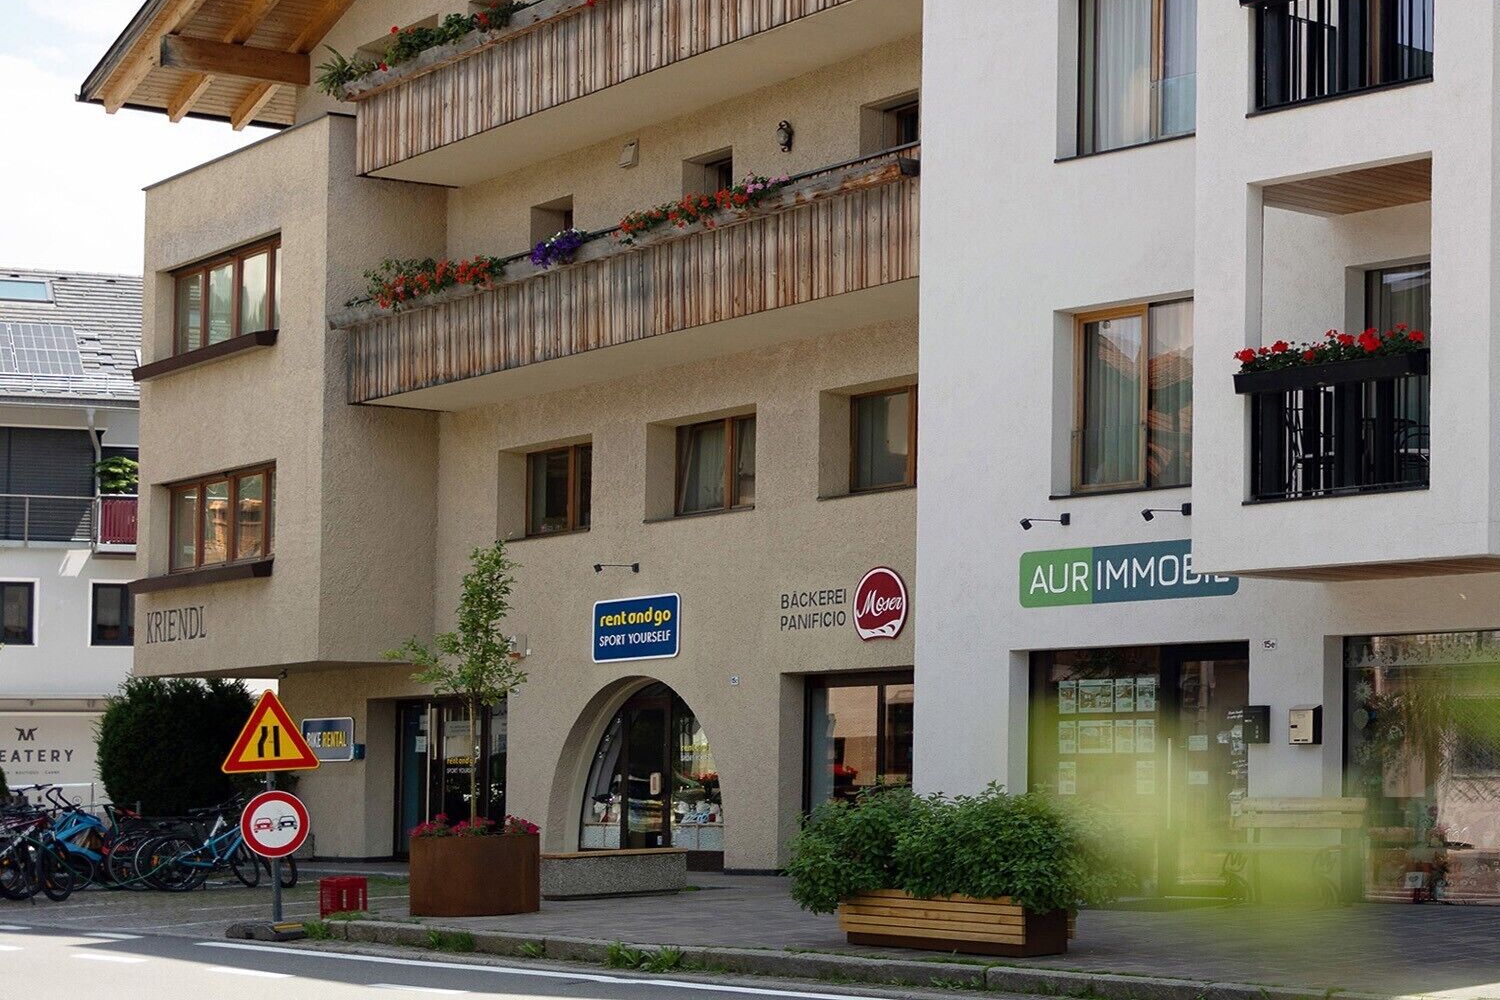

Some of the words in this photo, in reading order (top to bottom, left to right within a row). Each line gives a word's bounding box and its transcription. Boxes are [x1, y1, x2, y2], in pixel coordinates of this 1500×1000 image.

[781, 589, 847, 610] BÄCKEREI
[857, 590, 903, 618] Moser
[146, 605, 208, 644] KRIENDL
[780, 611, 846, 631] PANIFICIO
[599, 634, 625, 647] SPORT
[628, 629, 671, 644] YOURSELF
